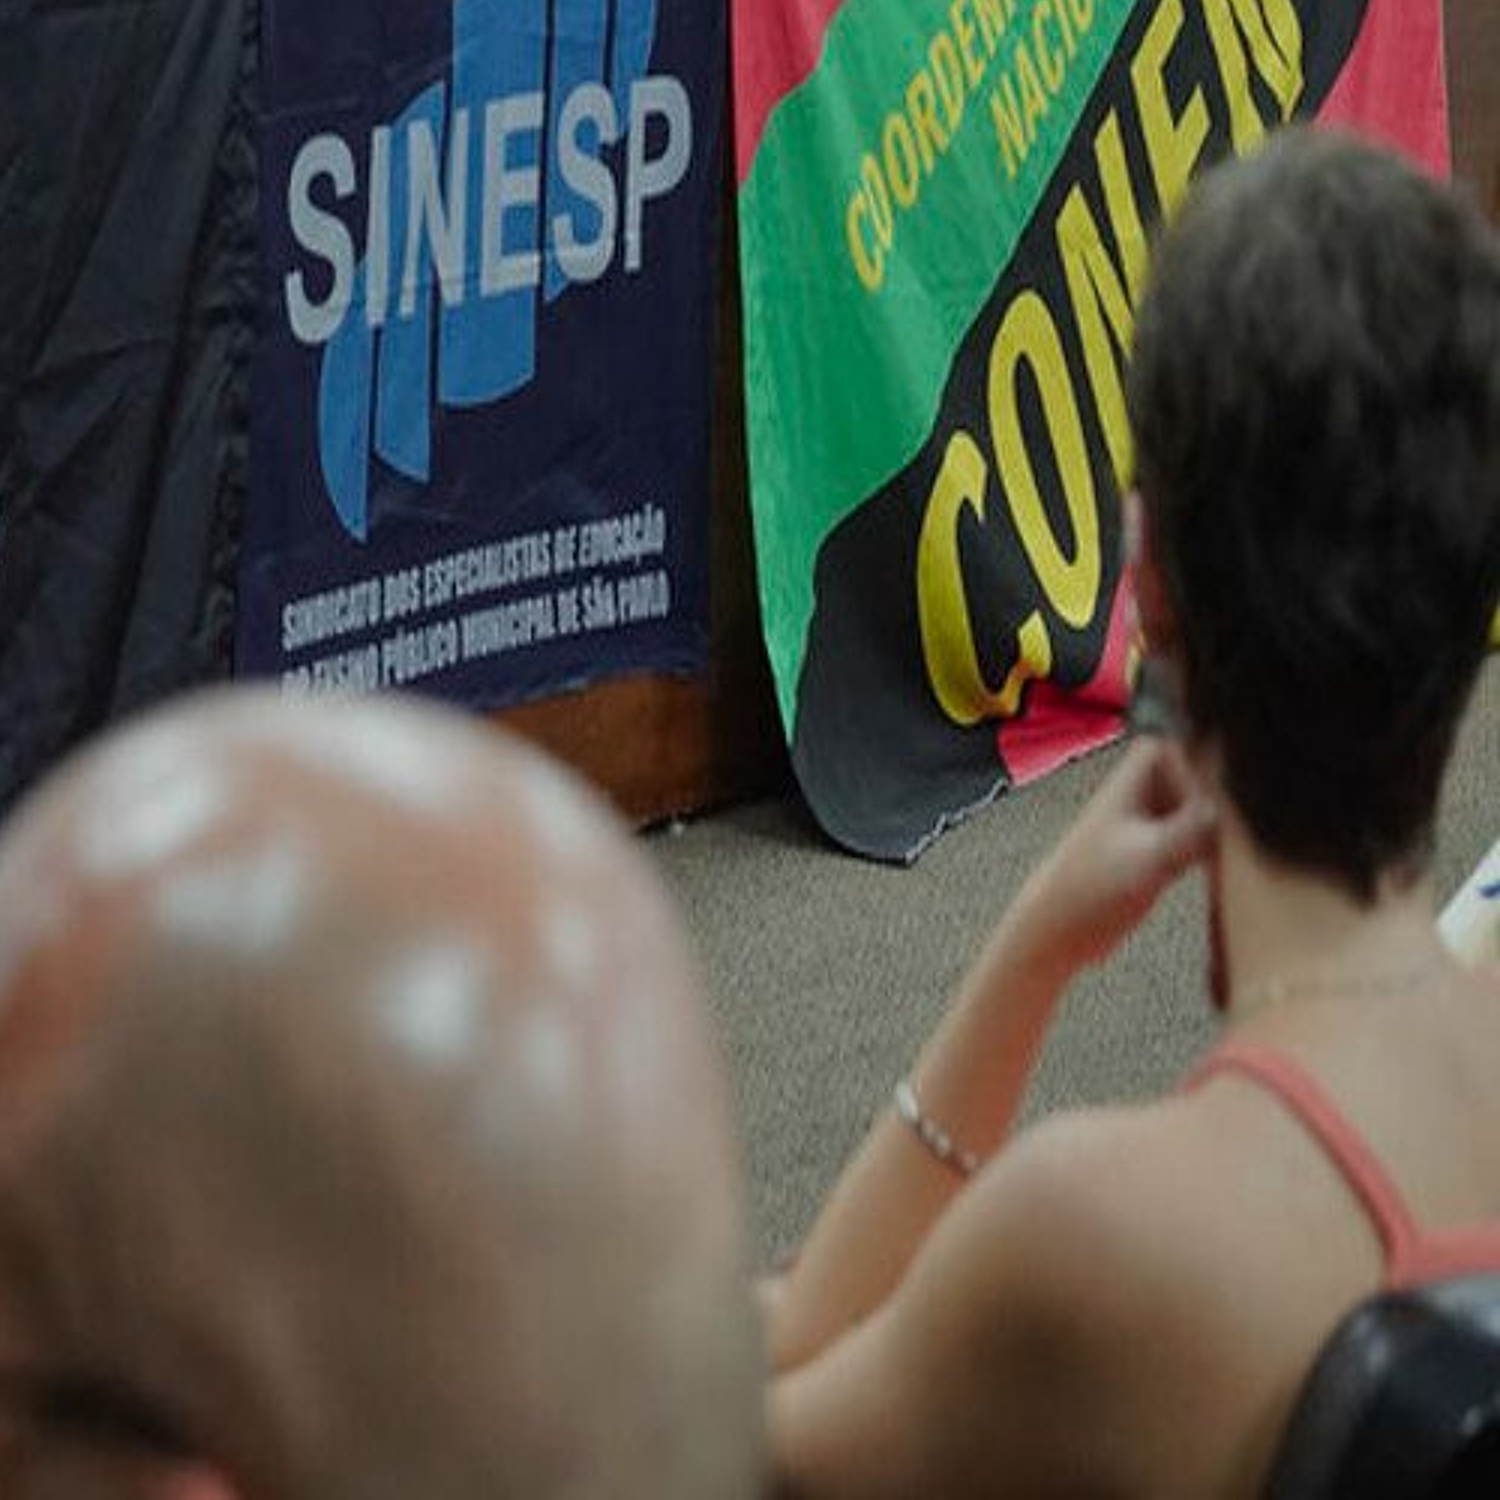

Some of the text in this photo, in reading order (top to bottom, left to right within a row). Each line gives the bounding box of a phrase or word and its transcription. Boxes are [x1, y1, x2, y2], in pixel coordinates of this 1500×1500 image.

[284, 73, 694, 345] SINESP
[282, 502, 665, 651] SINDICATO DOS ESPECIALISTAS DE EDUCAÇÃO
[381, 617, 458, 684] PÚBLICO
[460, 593, 556, 661] MUNICIPAL
[557, 584, 581, 635] DE
[581, 574, 617, 630] SÃO
[618, 568, 670, 623] PAULO
